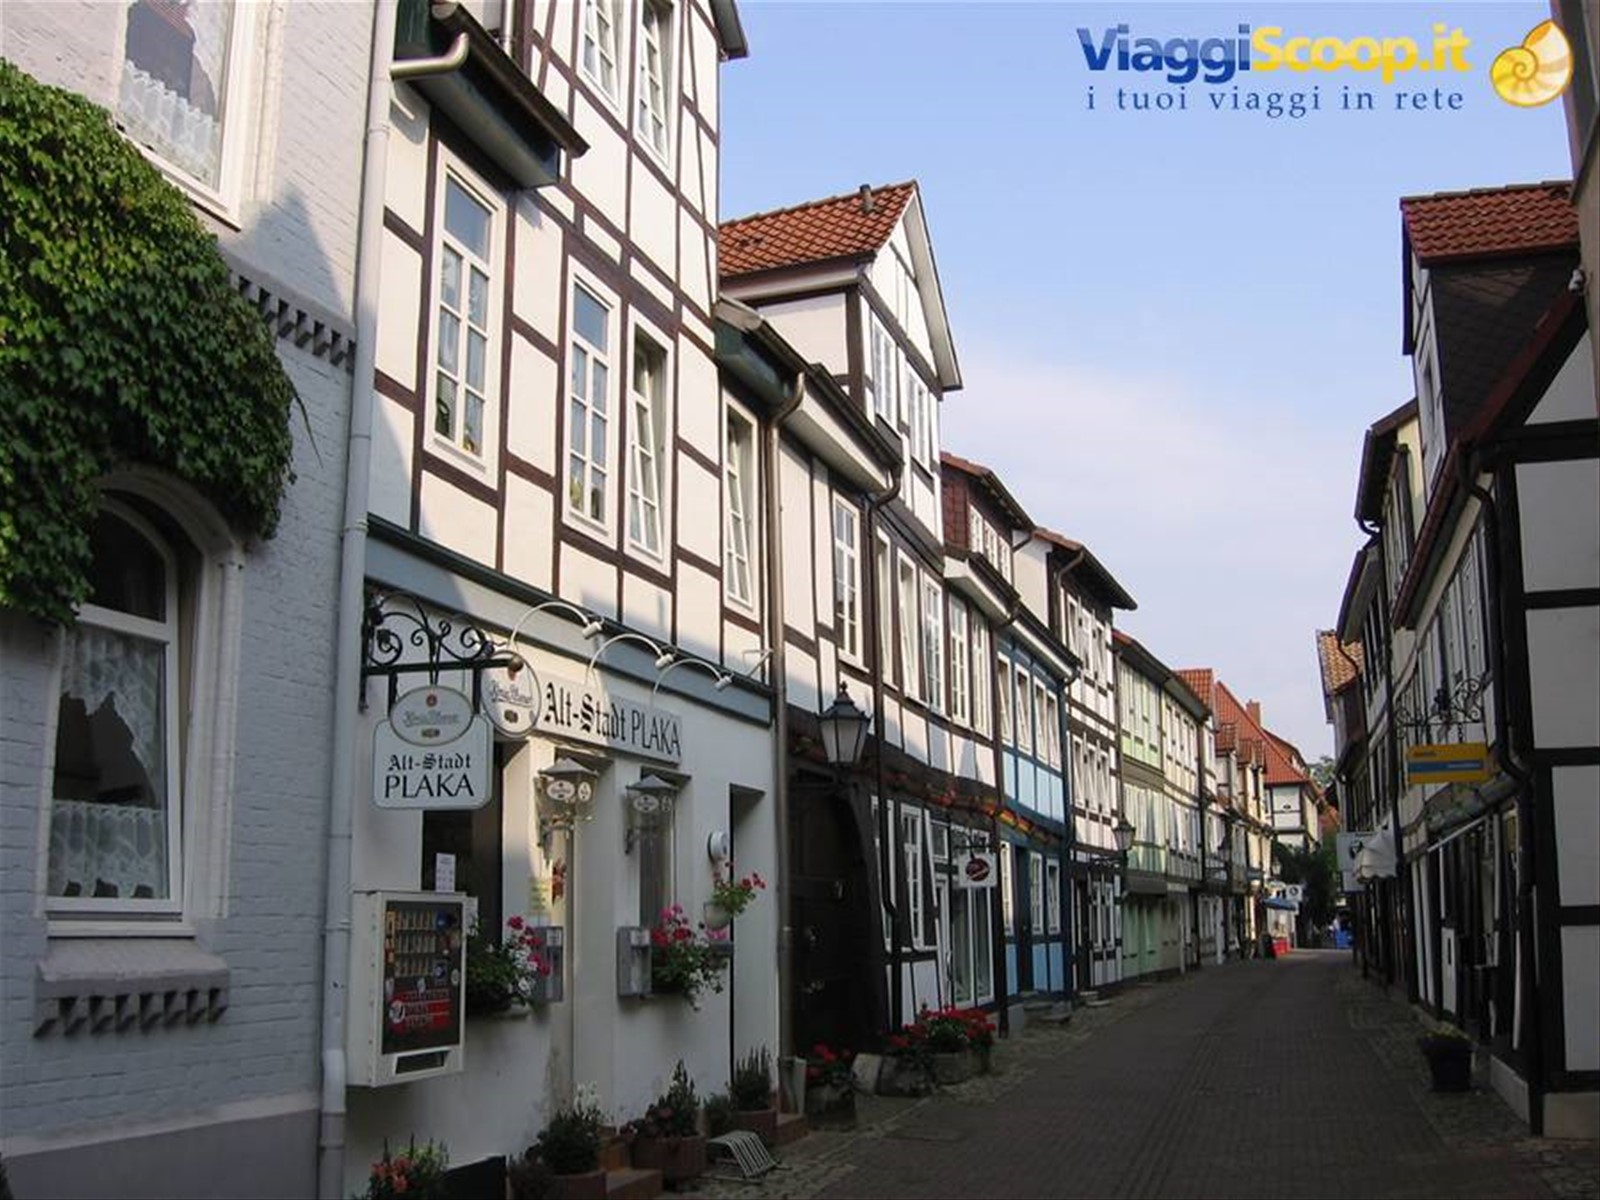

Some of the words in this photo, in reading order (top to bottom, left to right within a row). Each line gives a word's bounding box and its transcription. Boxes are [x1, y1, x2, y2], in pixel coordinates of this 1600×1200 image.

[543, 681, 626, 742] Alt-Stadt
[631, 709, 682, 757] PLAKA
[388, 752, 472, 771] Alt-Stadt
[384, 773, 475, 798] PLAKA
